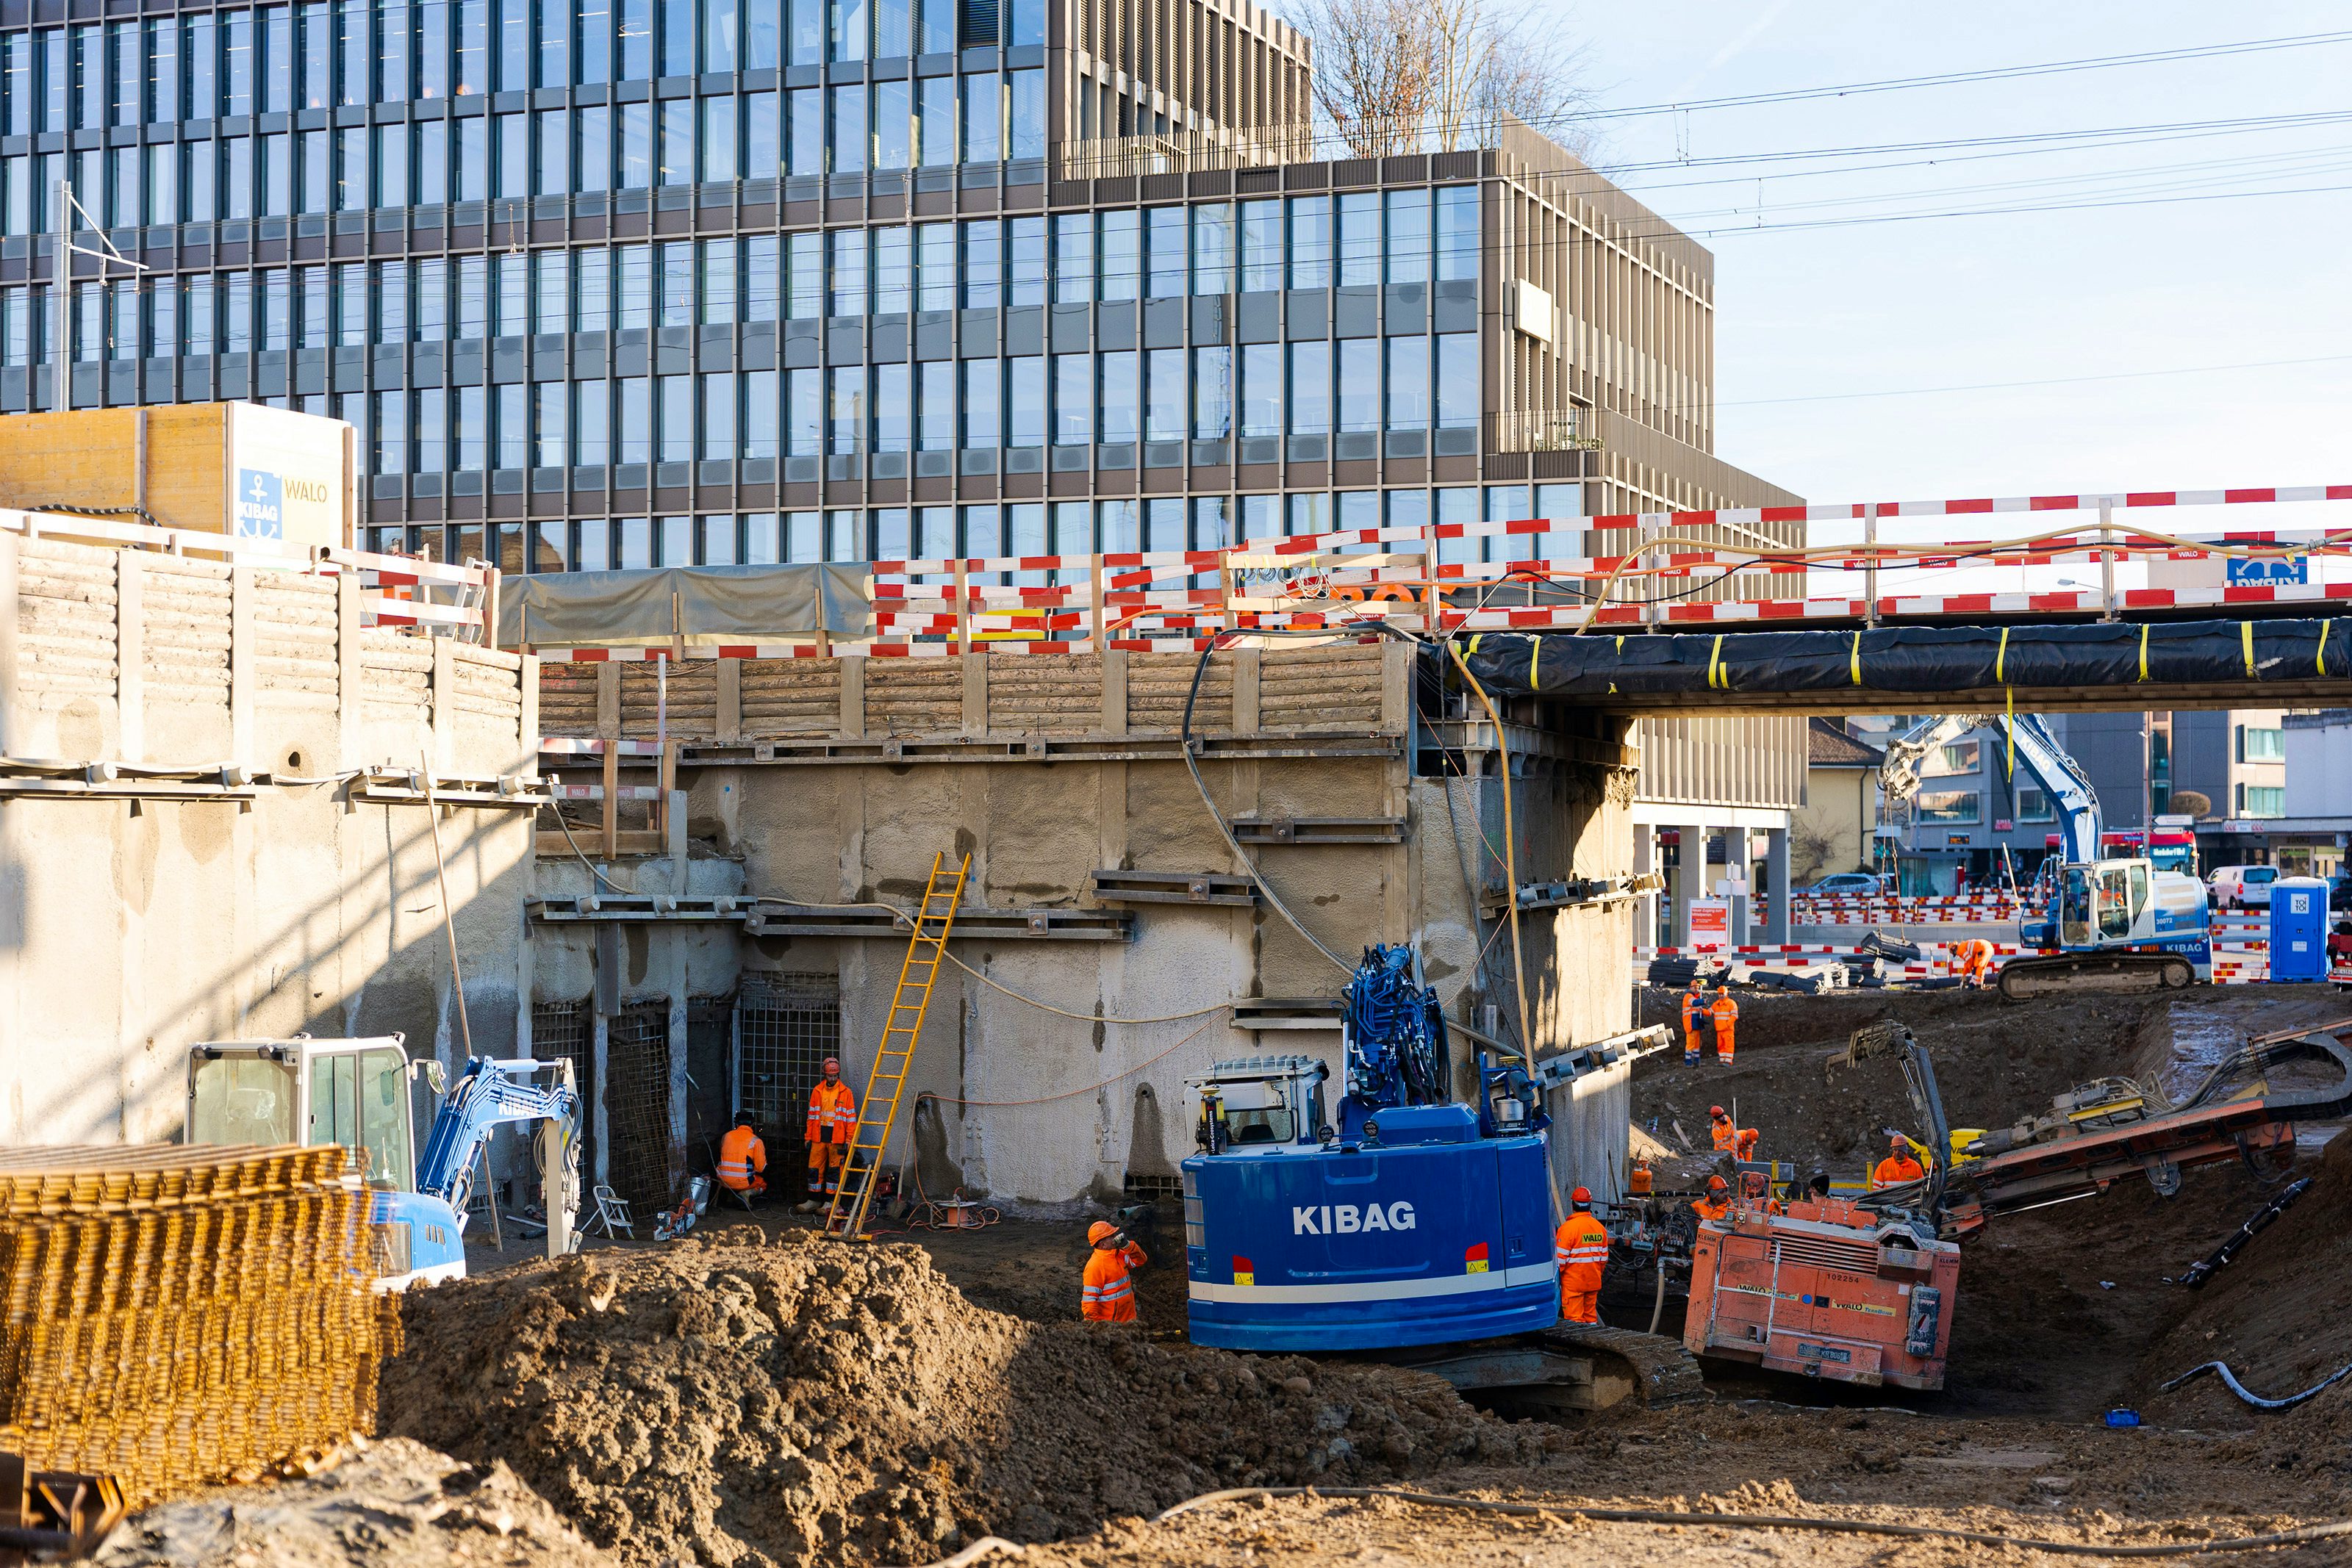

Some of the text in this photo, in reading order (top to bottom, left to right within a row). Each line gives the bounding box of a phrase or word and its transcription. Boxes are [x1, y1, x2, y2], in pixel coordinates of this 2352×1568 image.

[284, 479, 327, 503] WALO
[237, 501, 278, 522] KIBAG
[2020, 735, 2051, 772] KIBAG
[571, 788, 585, 796] WALO
[2166, 943, 2202, 952] KIBAG
[1293, 1201, 1416, 1235] KIBAG
[1698, 1234, 1716, 1242] KLEMM
[1827, 1273, 1859, 1283] 102254
